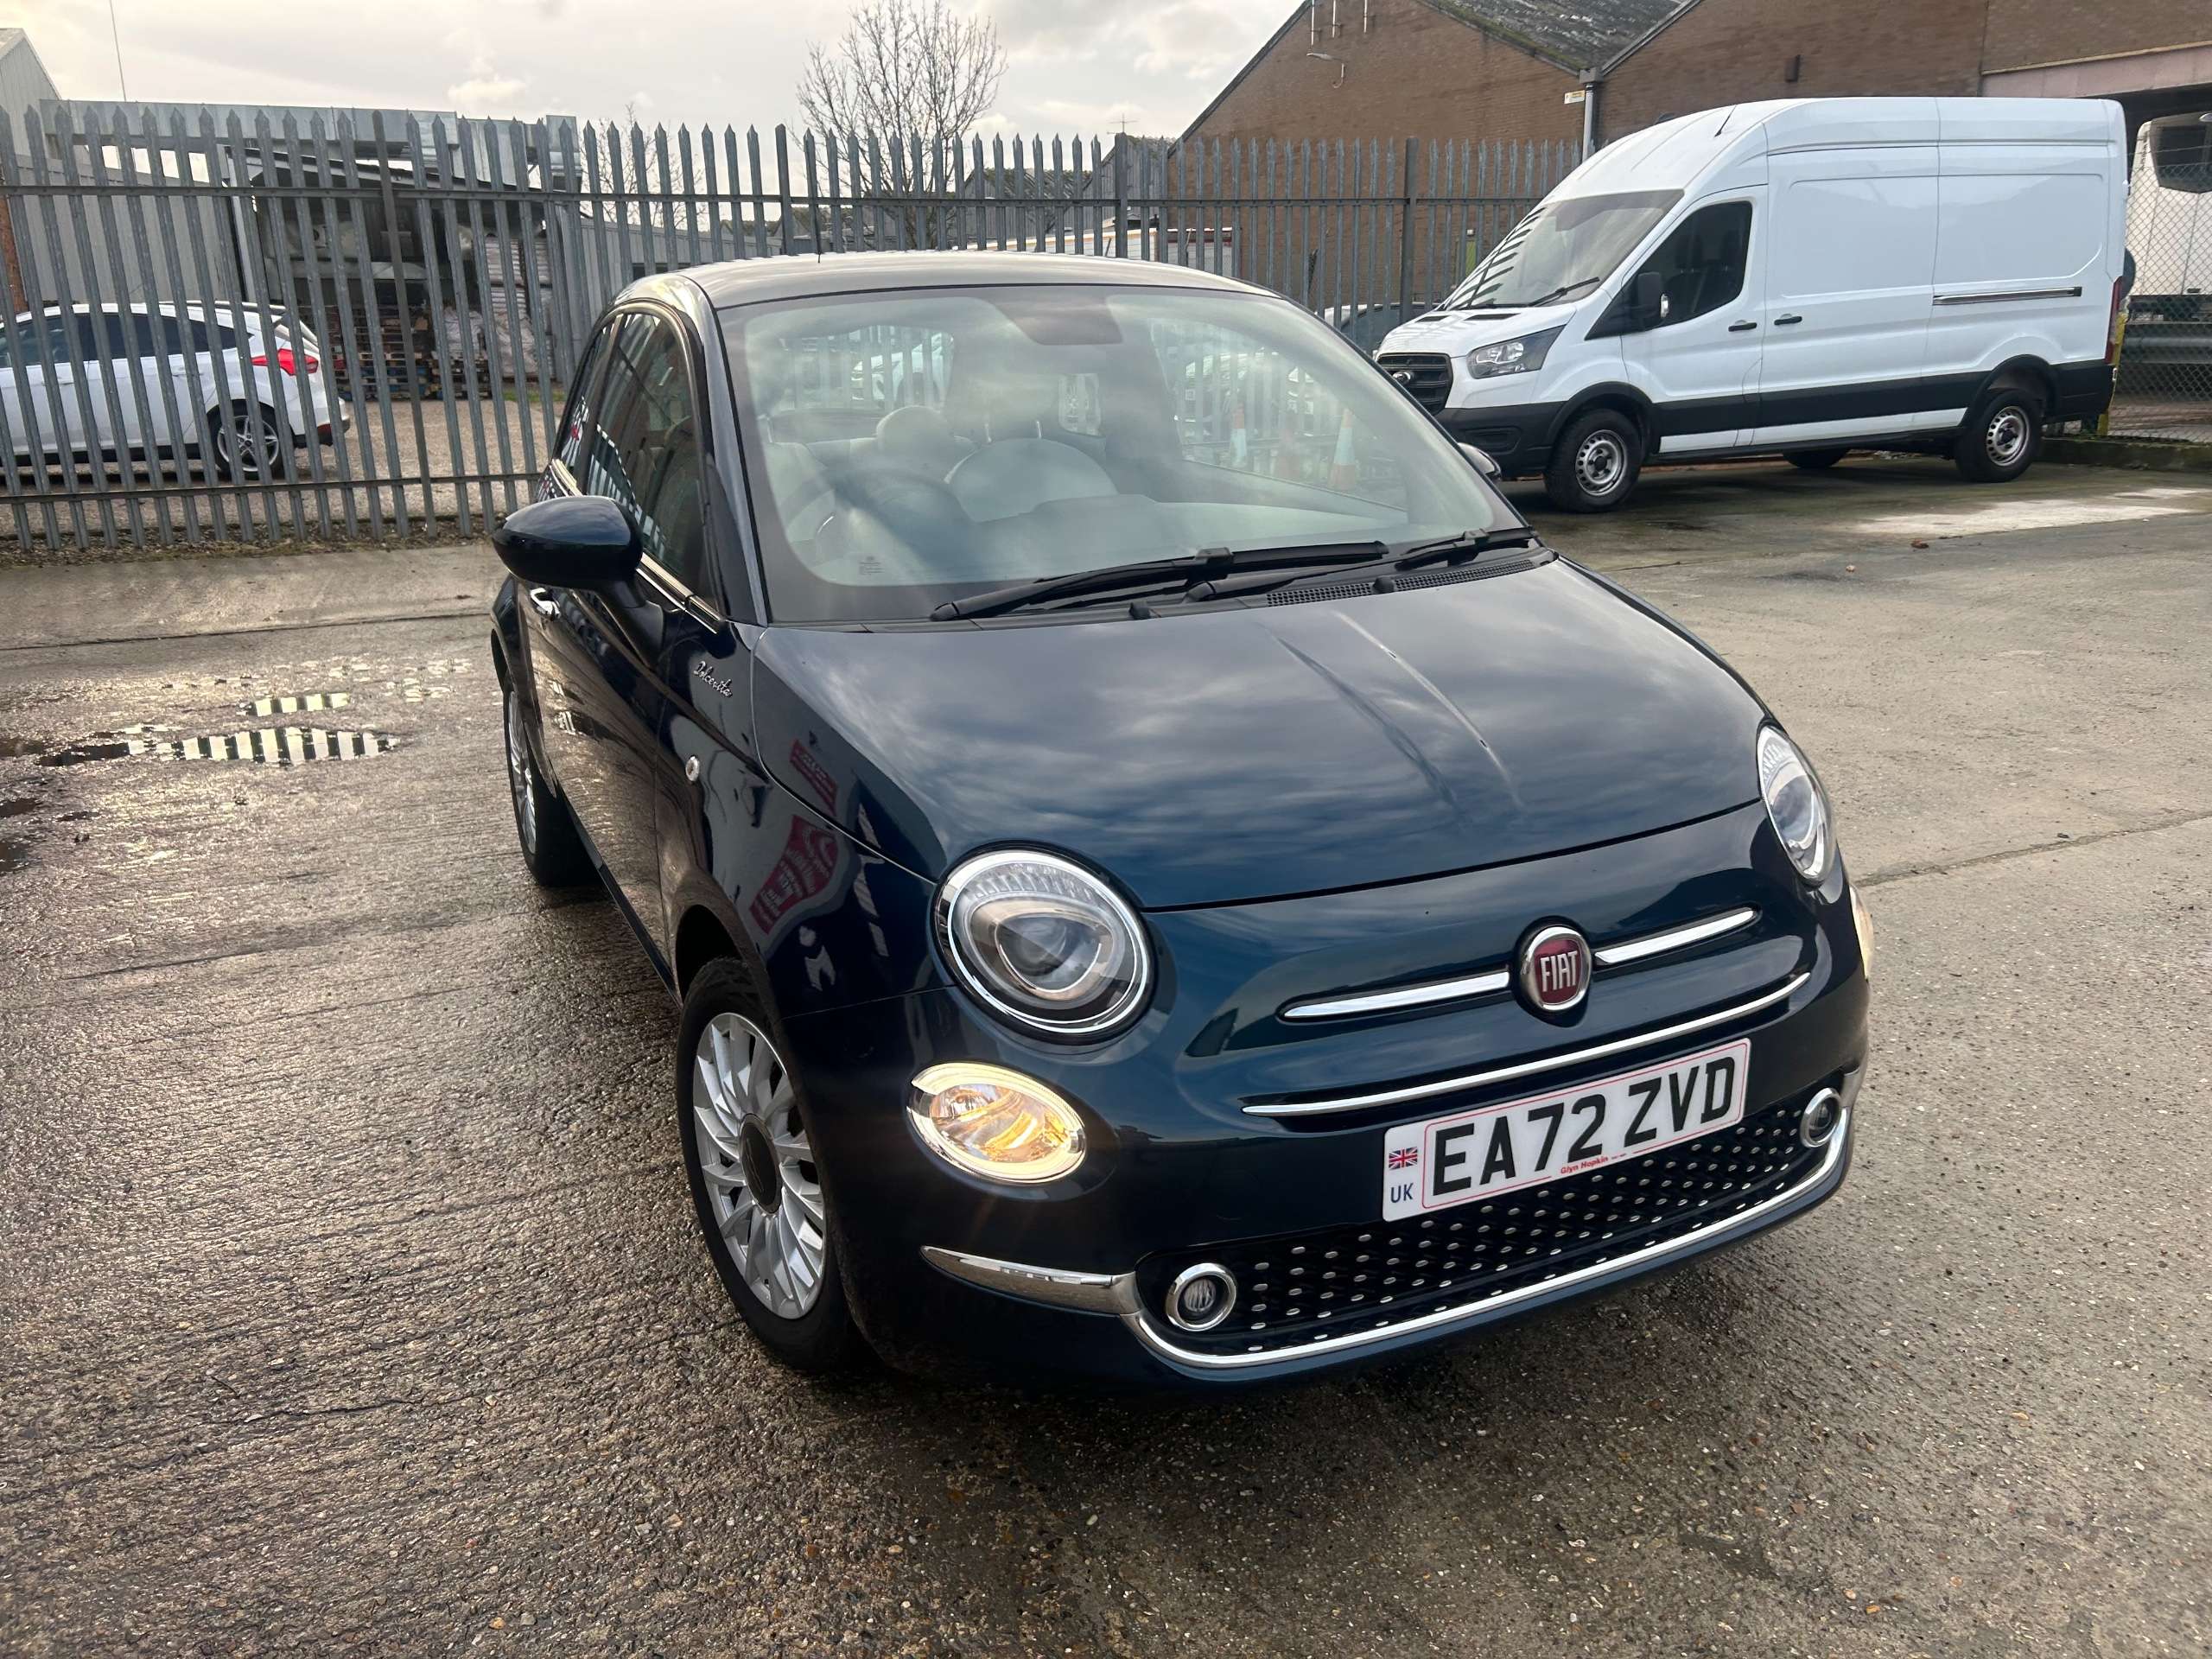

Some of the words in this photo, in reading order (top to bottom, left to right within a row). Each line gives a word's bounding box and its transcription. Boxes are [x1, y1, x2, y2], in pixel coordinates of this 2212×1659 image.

[1540, 950, 1578, 993] FIAT
[1433, 1094, 1606, 1196] EA72
[1624, 1056, 1735, 1147] ZVD
[1560, 1165, 1579, 1174] Glyn
[1390, 1182, 1414, 1204] UK
